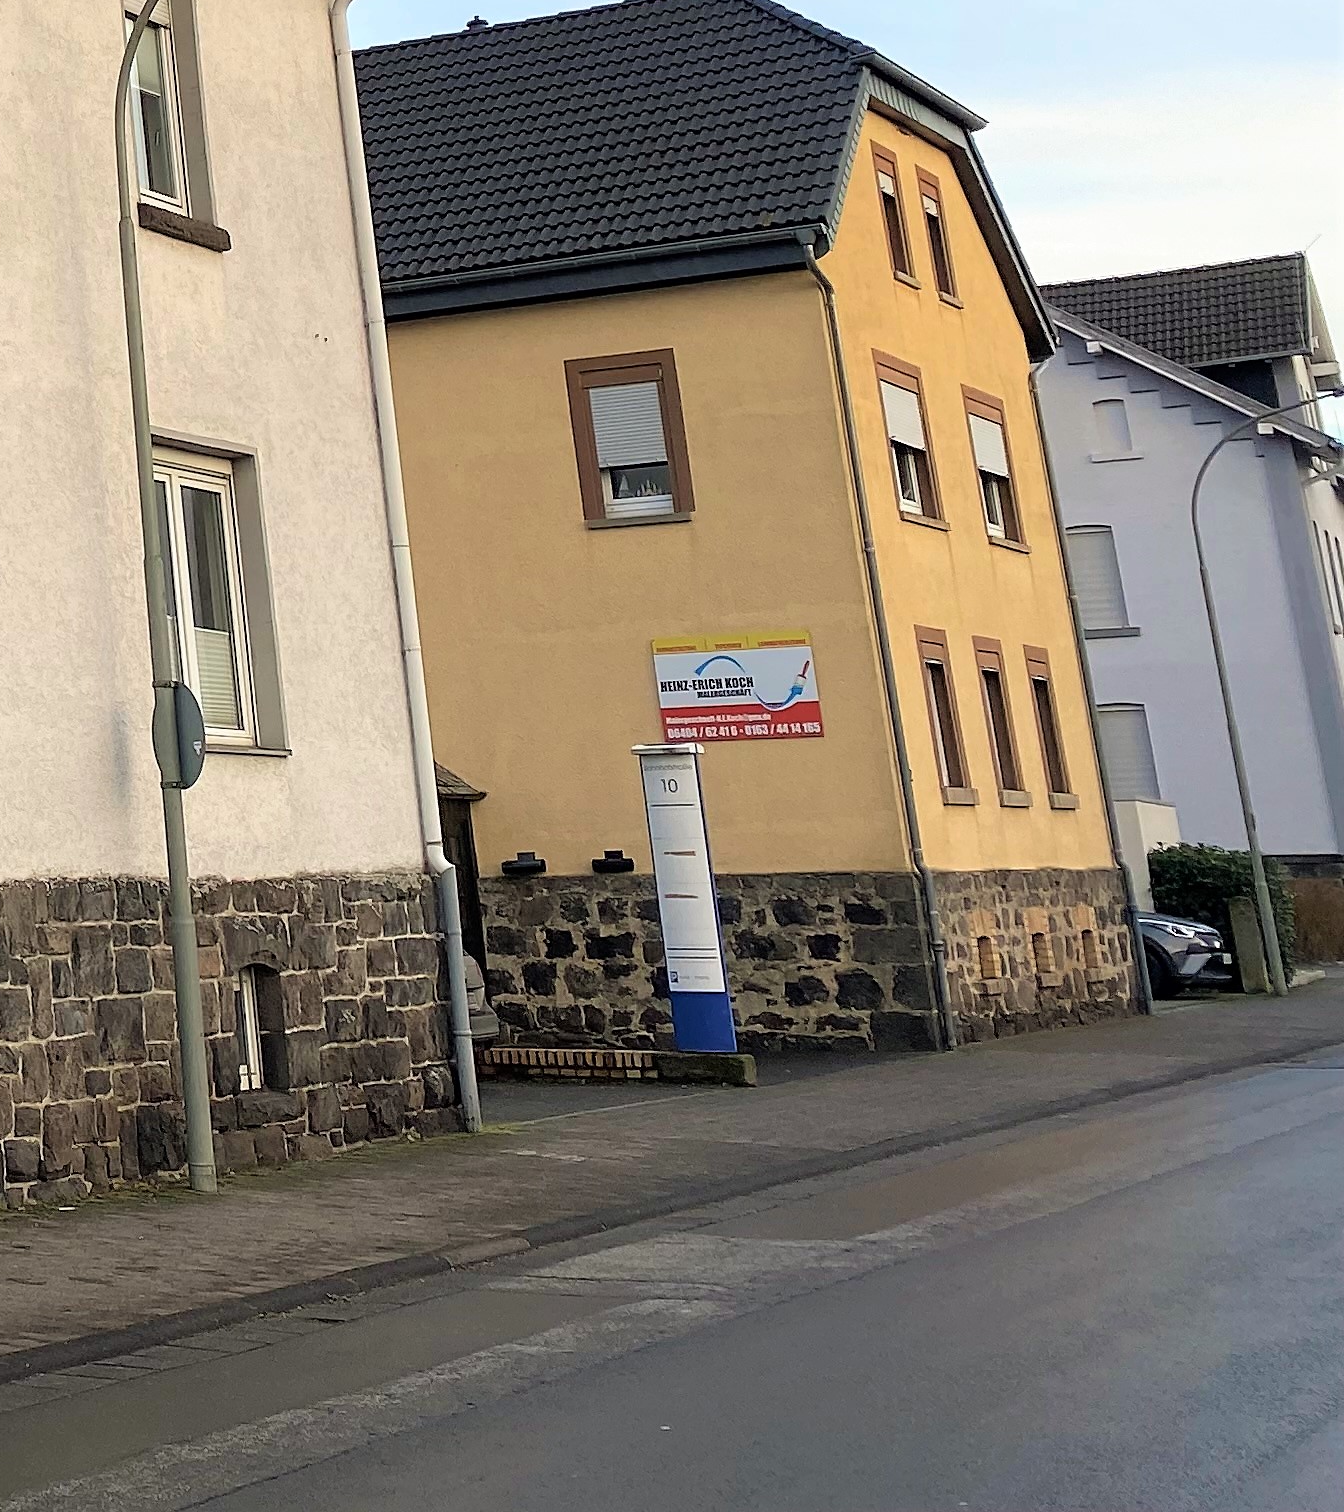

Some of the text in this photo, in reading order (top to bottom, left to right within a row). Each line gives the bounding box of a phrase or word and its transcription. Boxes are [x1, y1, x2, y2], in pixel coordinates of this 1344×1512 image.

[660, 676, 754, 693] HEINZ-ERICH KOCH
[667, 726, 698, 739] 06404
[660, 778, 679, 793] 10
